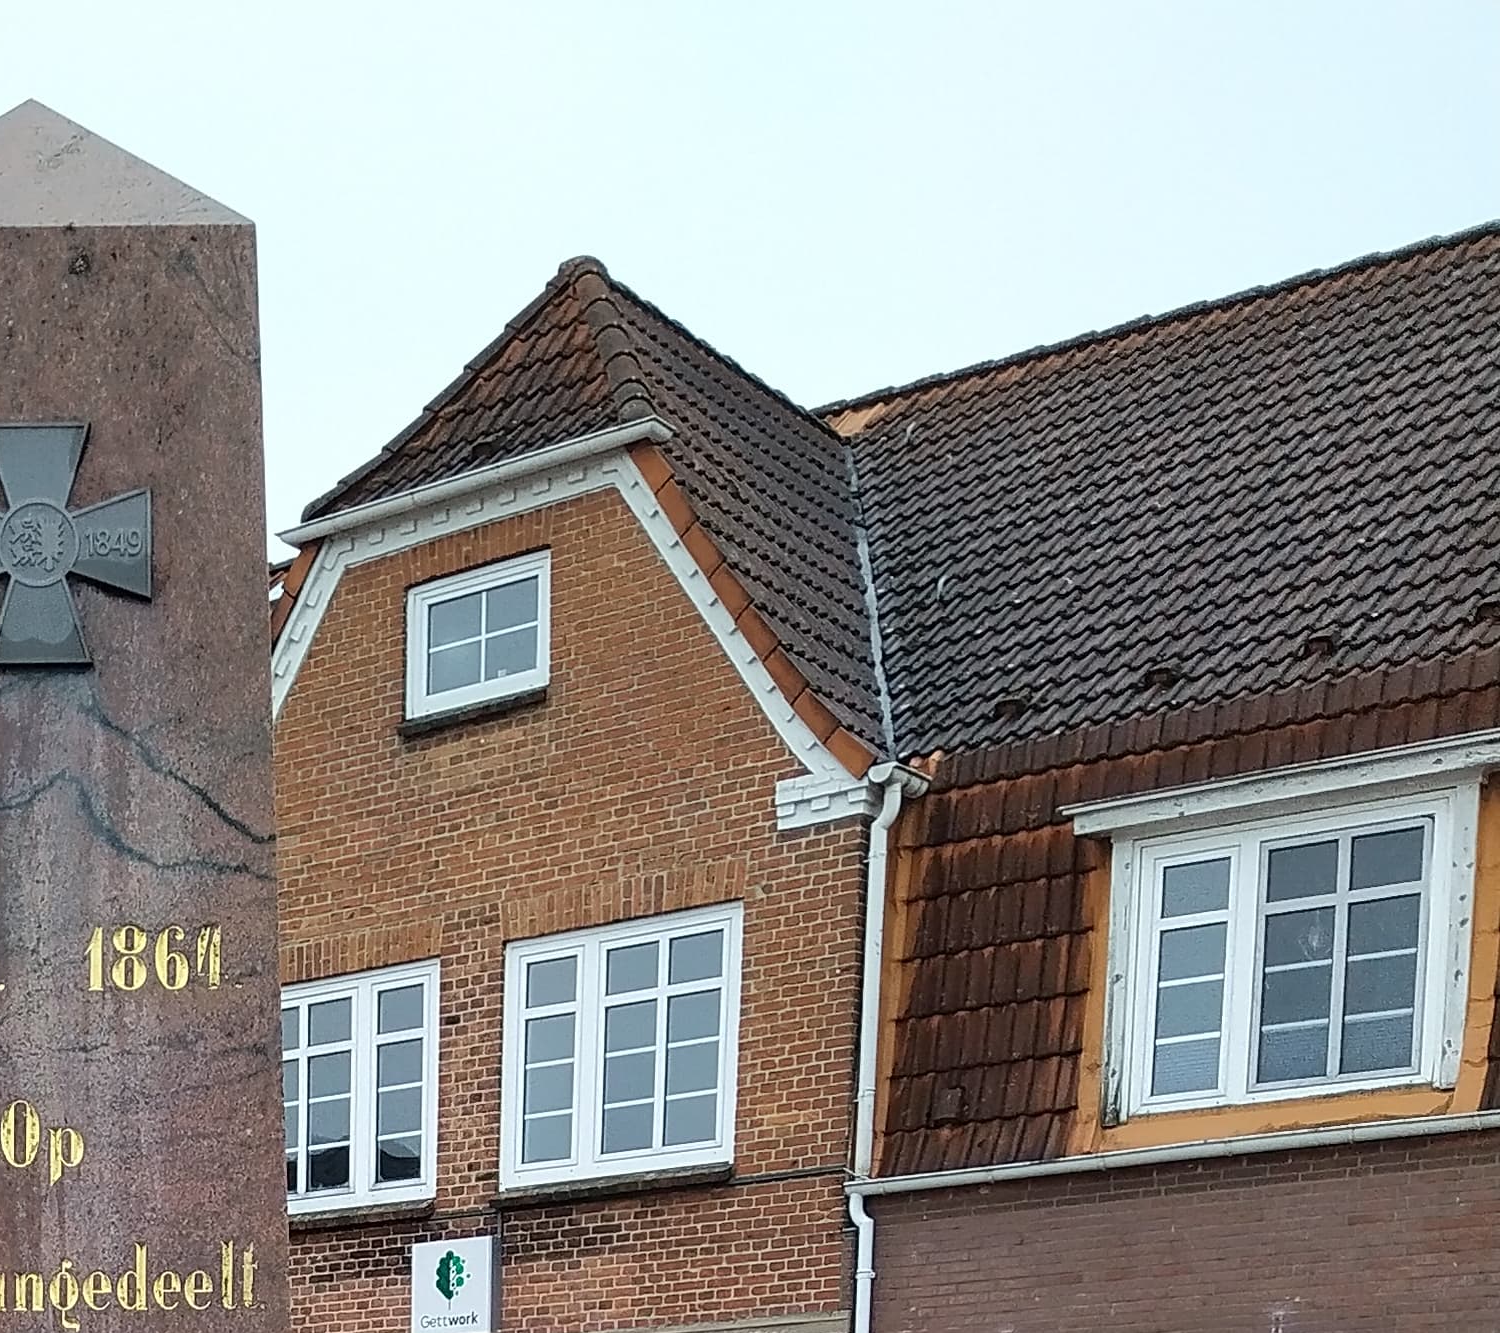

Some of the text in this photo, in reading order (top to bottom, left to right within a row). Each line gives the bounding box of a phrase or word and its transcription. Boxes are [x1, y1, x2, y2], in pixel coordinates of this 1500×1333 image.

[84, 530, 143, 558] 1849
[0, 1100, 85, 1187] Op
[420, 1311, 479, 1329] Gettwork
